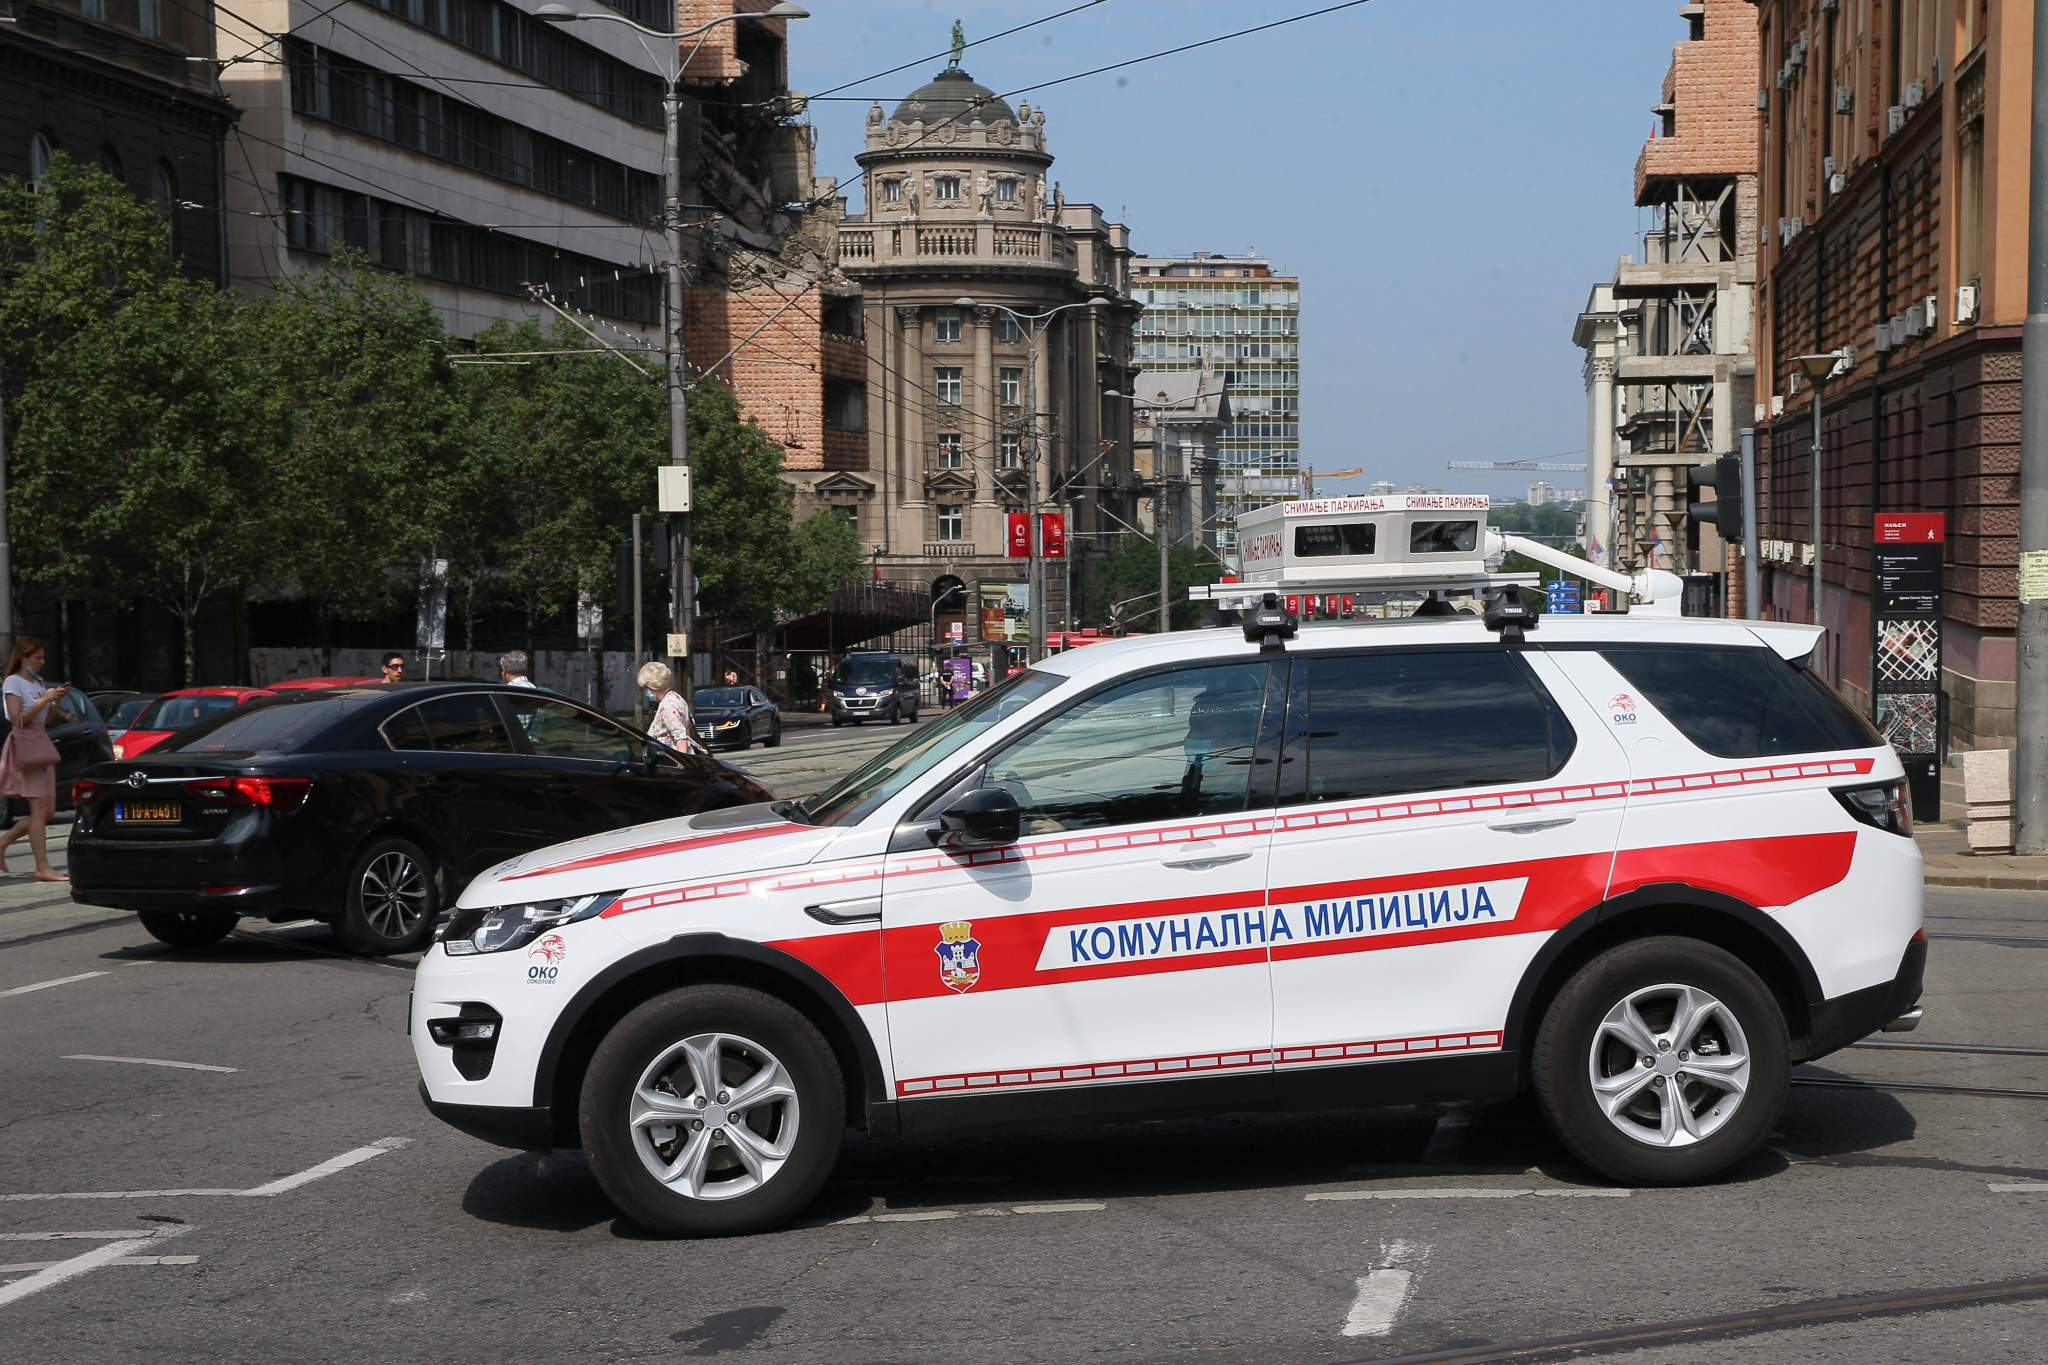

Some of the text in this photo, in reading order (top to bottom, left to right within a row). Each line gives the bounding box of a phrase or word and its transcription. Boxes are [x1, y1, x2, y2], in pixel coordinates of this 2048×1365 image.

[1284, 498, 1385, 515] СНИМАЊЕ ПАРКИРАЊА
[1405, 496, 1489, 509] СНИМАЊЕ ПАРКИРАЊА
[1613, 713, 1637, 722] ОКО
[1069, 886, 1496, 962] КОМУНАЛНА МИЛИЦИЈА
[528, 966, 558, 979] ОКО
